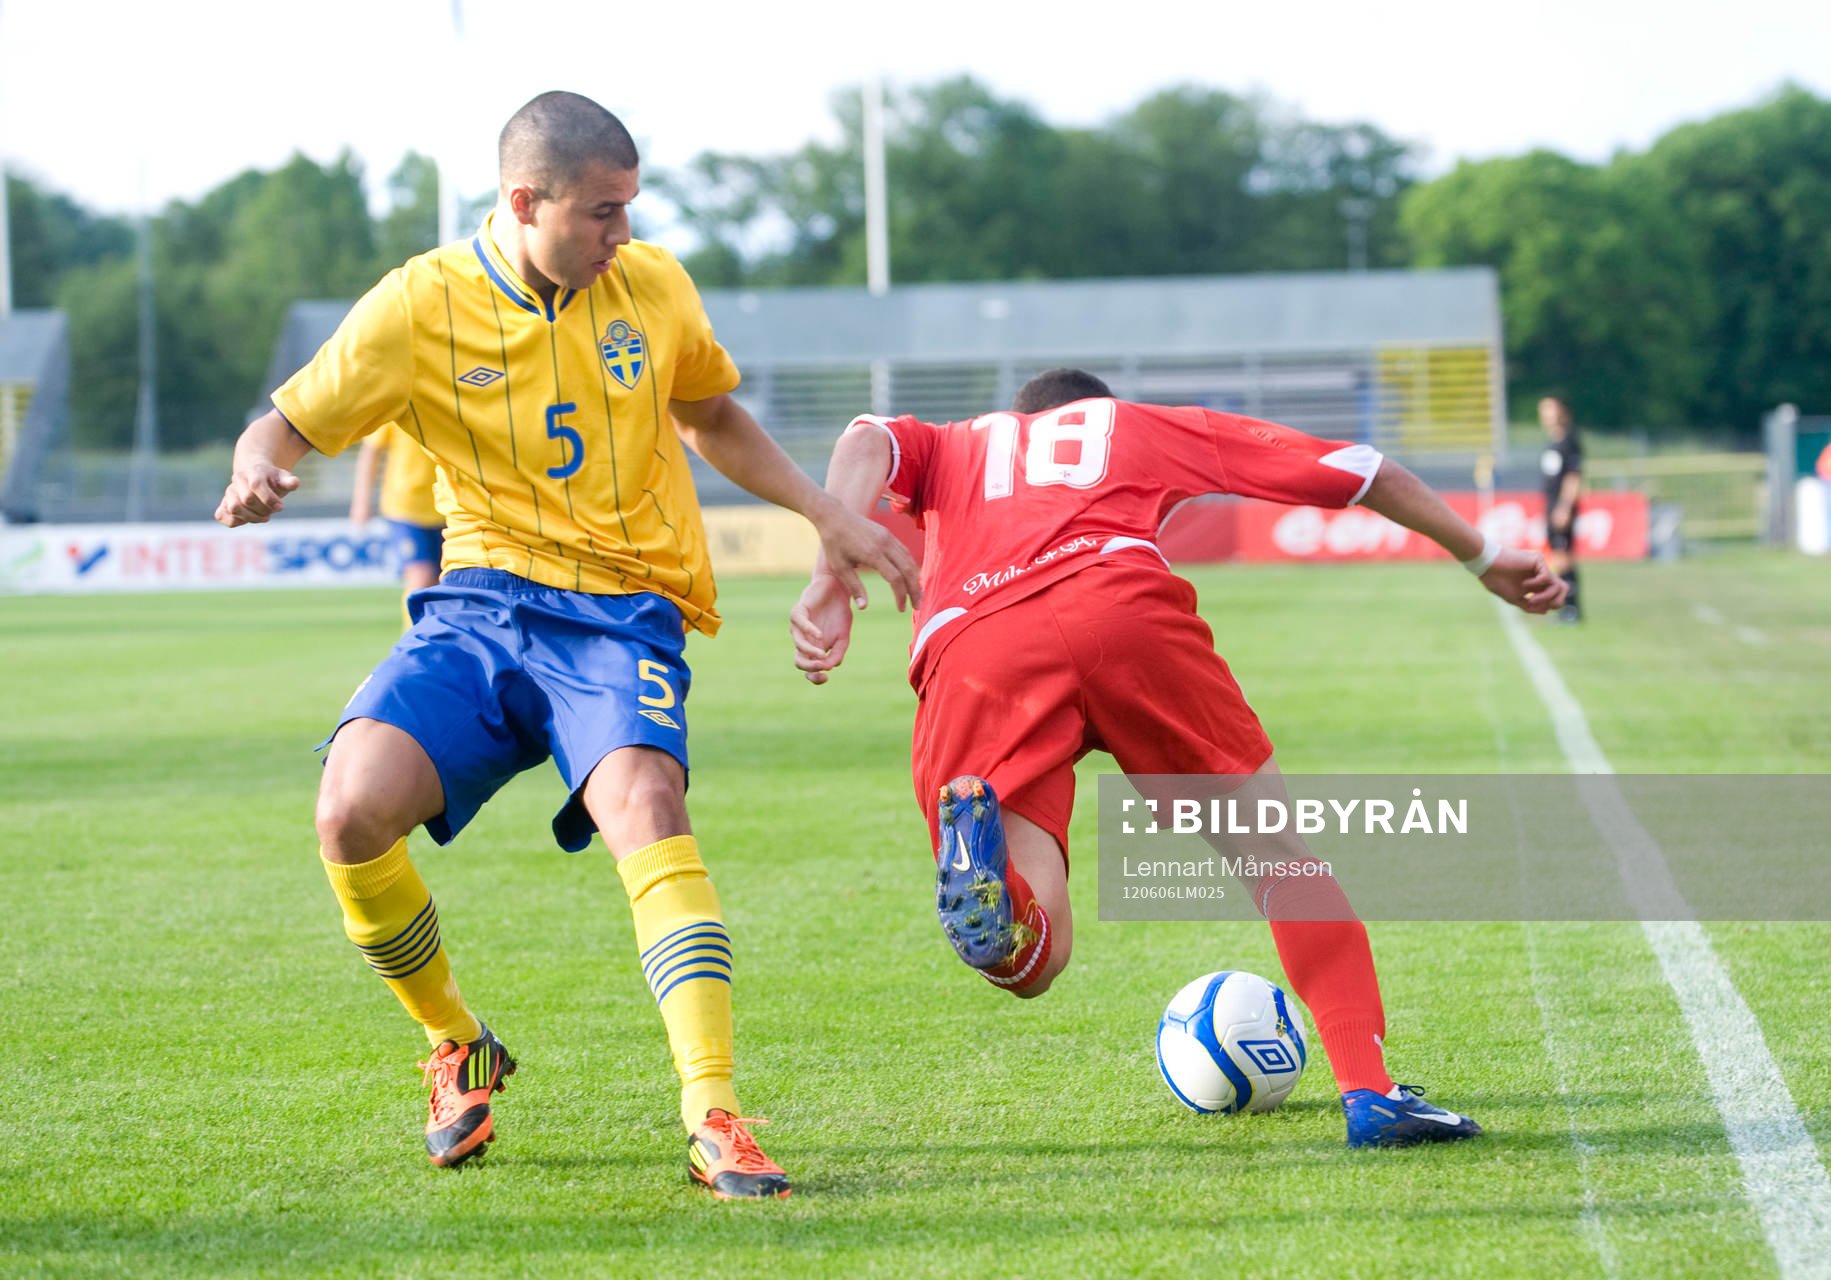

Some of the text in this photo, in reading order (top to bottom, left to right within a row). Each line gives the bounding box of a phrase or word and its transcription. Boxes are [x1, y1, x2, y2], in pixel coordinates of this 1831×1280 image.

[546, 401, 585, 480] 5
[970, 397, 1117, 502] 18
[638, 658, 676, 709] 5
